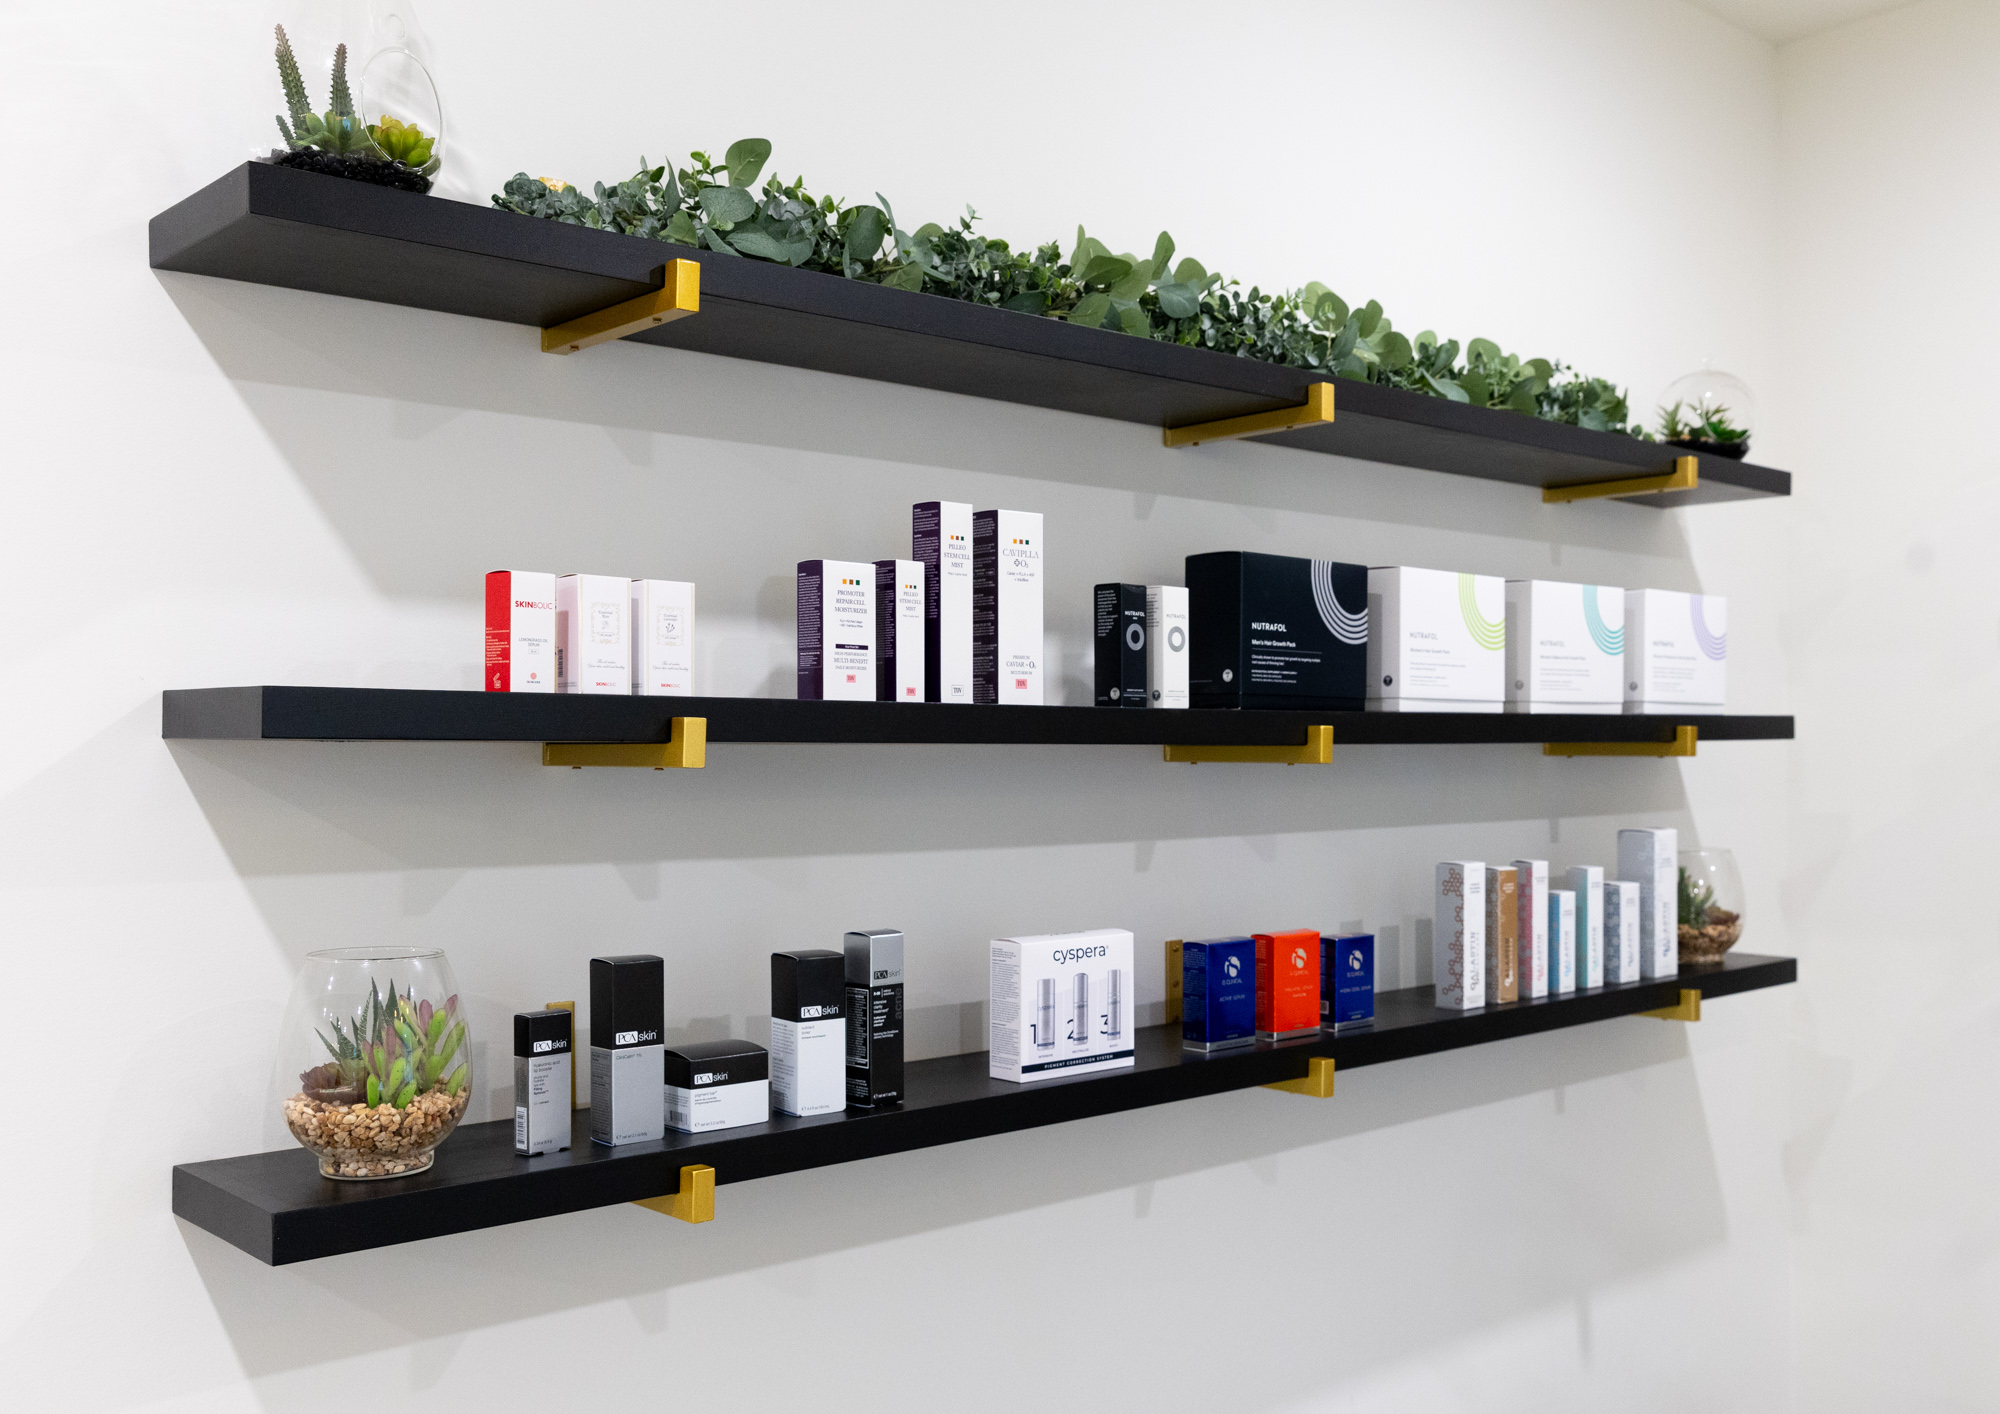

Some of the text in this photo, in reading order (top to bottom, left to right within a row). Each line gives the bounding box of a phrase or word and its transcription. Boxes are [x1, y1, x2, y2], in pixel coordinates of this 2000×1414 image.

[1003, 549, 1039, 559] CAVIPLLA
[514, 600, 553, 610] SKINBOLIC
[835, 606, 868, 614] MOISTURIZER
[1125, 610, 1146, 618] NUTRAFOL
[1251, 622, 1287, 632] NUTRAFOL
[1409, 632, 1438, 640] NUTRAFOL
[1006, 661, 1024, 669] CAVIAR
[1053, 945, 1107, 965] cyspera
[874, 971, 888, 980] PCA
[803, 1005, 839, 1017] PCA skin
[618, 1031, 657, 1044] PCA skin
[1030, 1023, 1037, 1044] 1
[535, 1040, 567, 1052] PCA skin
[1044, 1061, 1065, 1069] PIGMENT
[1066, 1057, 1095, 1066] CORRECTION
[696, 1072, 728, 1084] PCA skin
